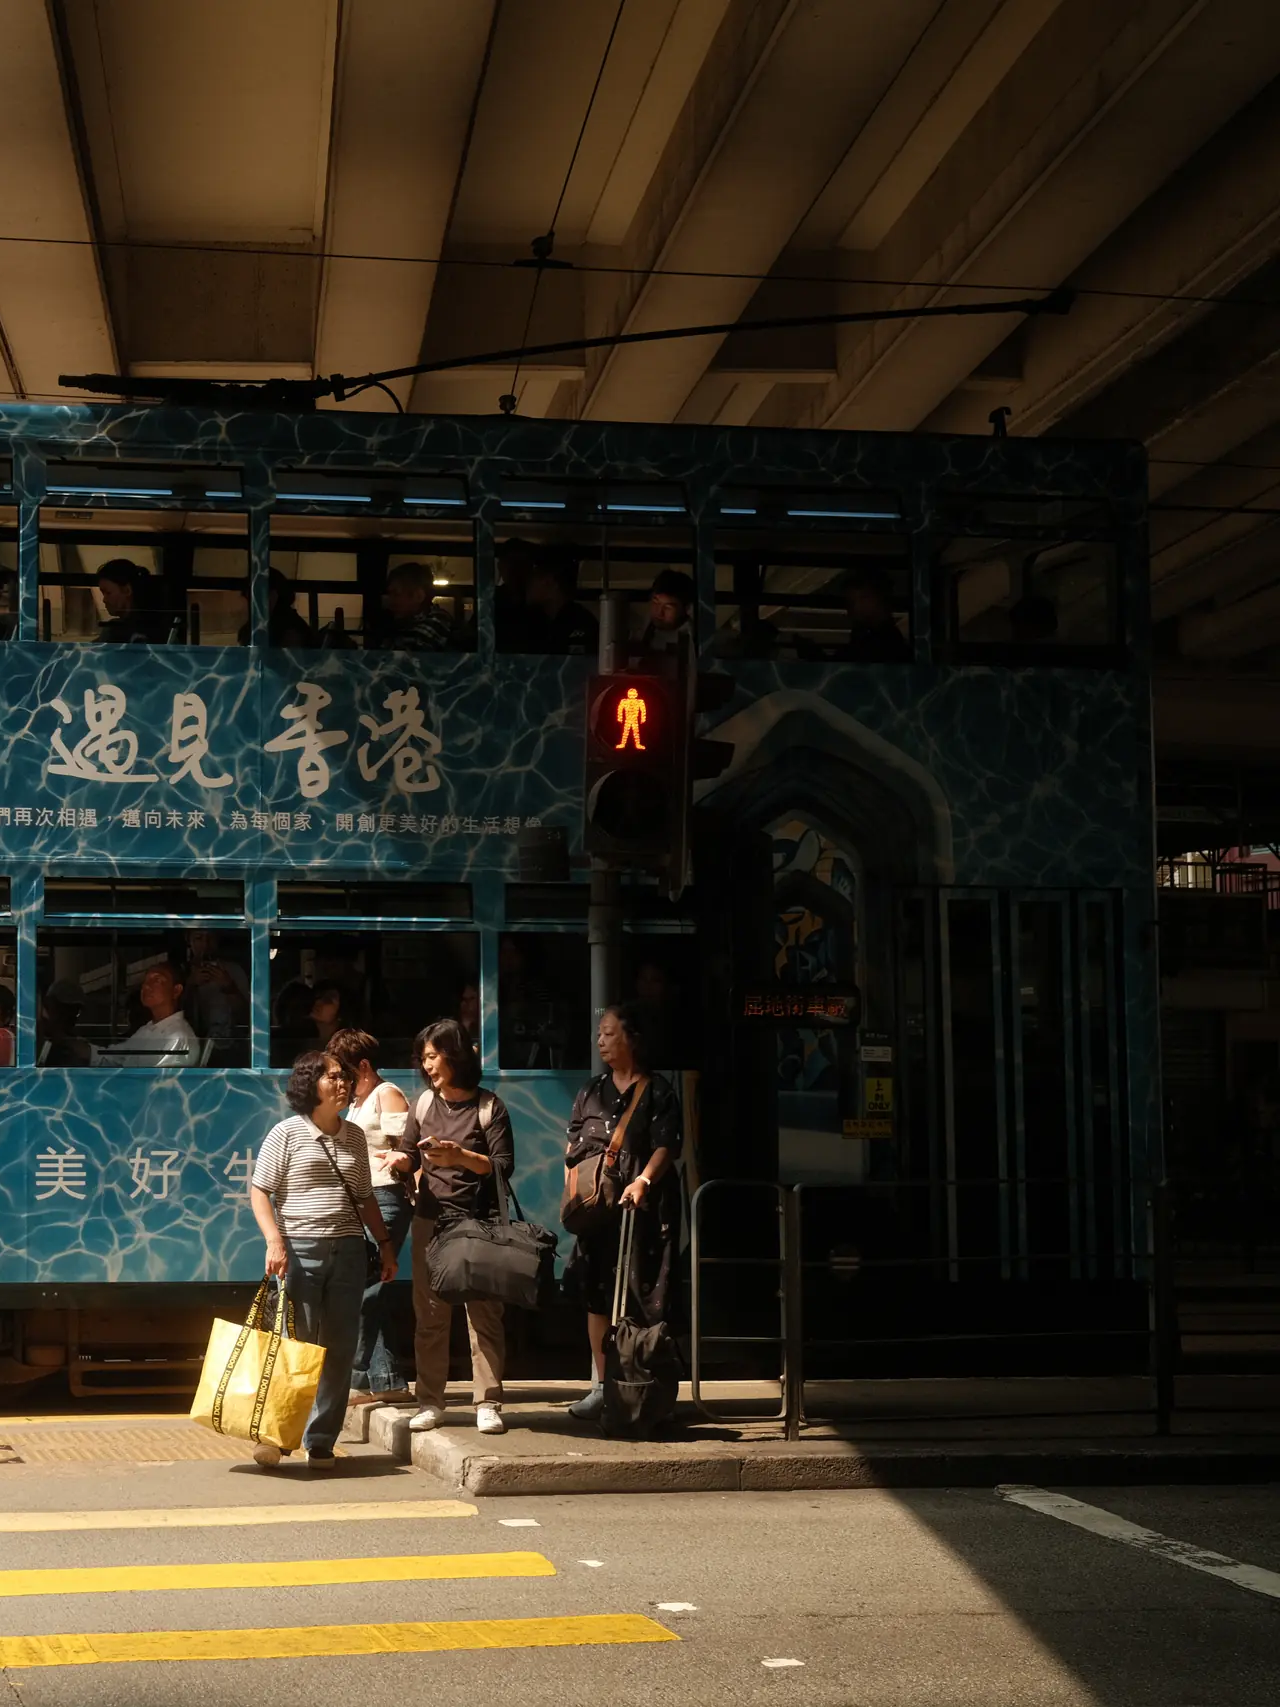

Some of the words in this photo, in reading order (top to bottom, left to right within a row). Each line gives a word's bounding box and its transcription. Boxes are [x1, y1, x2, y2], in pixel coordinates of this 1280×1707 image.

[47, 685, 234, 789] 遇見
[263, 680, 443, 800] 香港
[245, 1303, 259, 1326] DONKI
[237, 1325, 251, 1347] DONKI
[269, 1334, 280, 1356] DONKI
[227, 1346, 241, 1369] DONKI
[263, 1356, 274, 1379] DONKI
[218, 1369, 232, 1392] DONKI
[257, 1378, 268, 1402] DONKI
[214, 1393, 224, 1416] DONKI
[252, 1403, 263, 1427] DONKI
